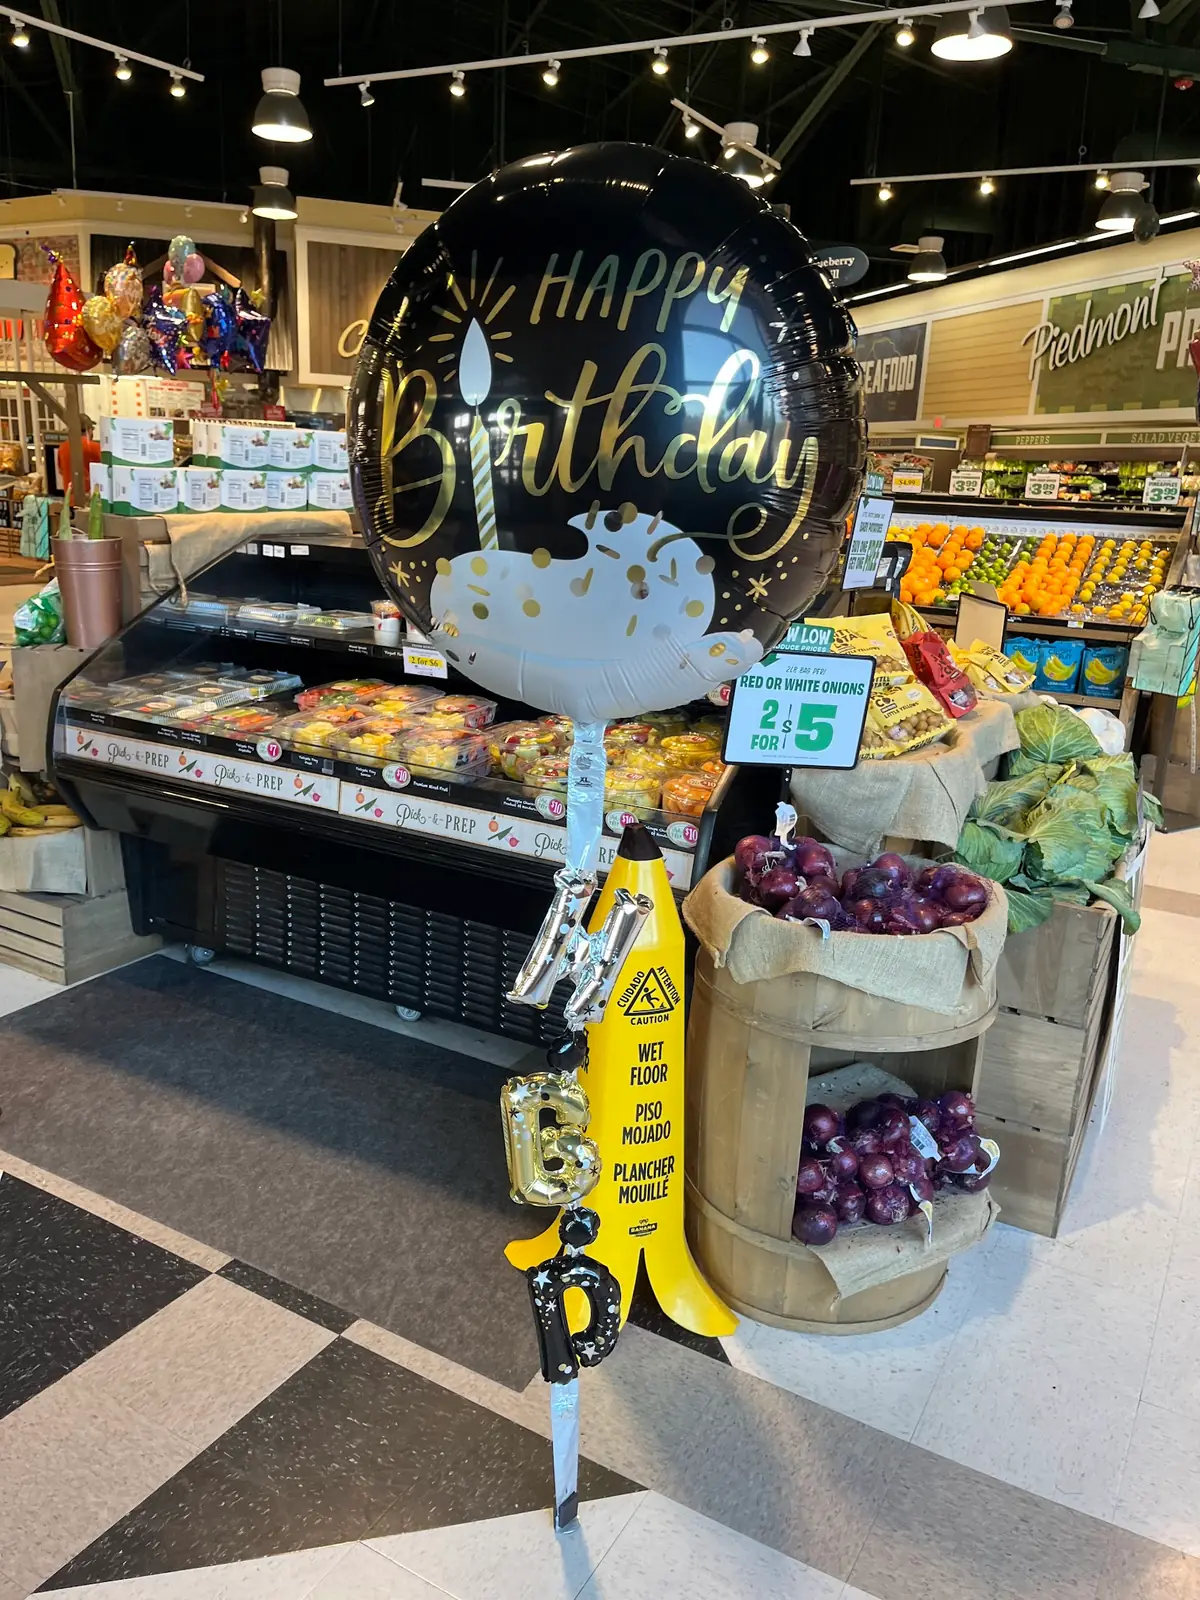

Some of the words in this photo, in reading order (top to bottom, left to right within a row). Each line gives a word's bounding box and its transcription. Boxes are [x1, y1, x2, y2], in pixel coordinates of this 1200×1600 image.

[531, 248, 749, 332] HAPPY
[1021, 266, 1167, 381] Piedmont
[1015, 435, 1050, 445] PEPPERS
[1131, 433, 1165, 443] SALAD
[801, 627, 831, 645] LOW
[411, 656, 416, 664] 2
[417, 656, 428, 666] for
[740, 675, 764, 689] RED
[765, 677, 782, 690] OR
[785, 678, 820, 693] WHITE
[822, 682, 865, 696] ONIONS
[759, 699, 779, 730] 2
[750, 734, 779, 751] FOR
[108, 743, 131, 764] Pick
[145, 751, 169, 768] PREP
[214, 764, 241, 785] Pick
[256, 773, 283, 791] PREP
[396, 769, 408, 782] $10
[396, 803, 426, 827] Pick
[445, 814, 476, 834] PREP
[550, 800, 562, 815] $10
[534, 832, 567, 858] Pick
[685, 827, 698, 841] $10
[616, 970, 645, 1008] CUIDADO
[657, 966, 681, 1005] ATTENTION
[630, 1013, 669, 1026] CAUTION
[638, 1041, 664, 1063] WET
[630, 1063, 668, 1086] FLOOR
[635, 1100, 662, 1122] PISO
[622, 1120, 671, 1145] MOJADO
[613, 1155, 675, 1182] PLANCHER
[618, 1174, 669, 1204] MOUILLÉ
[630, 1223, 656, 1233] BANANA
